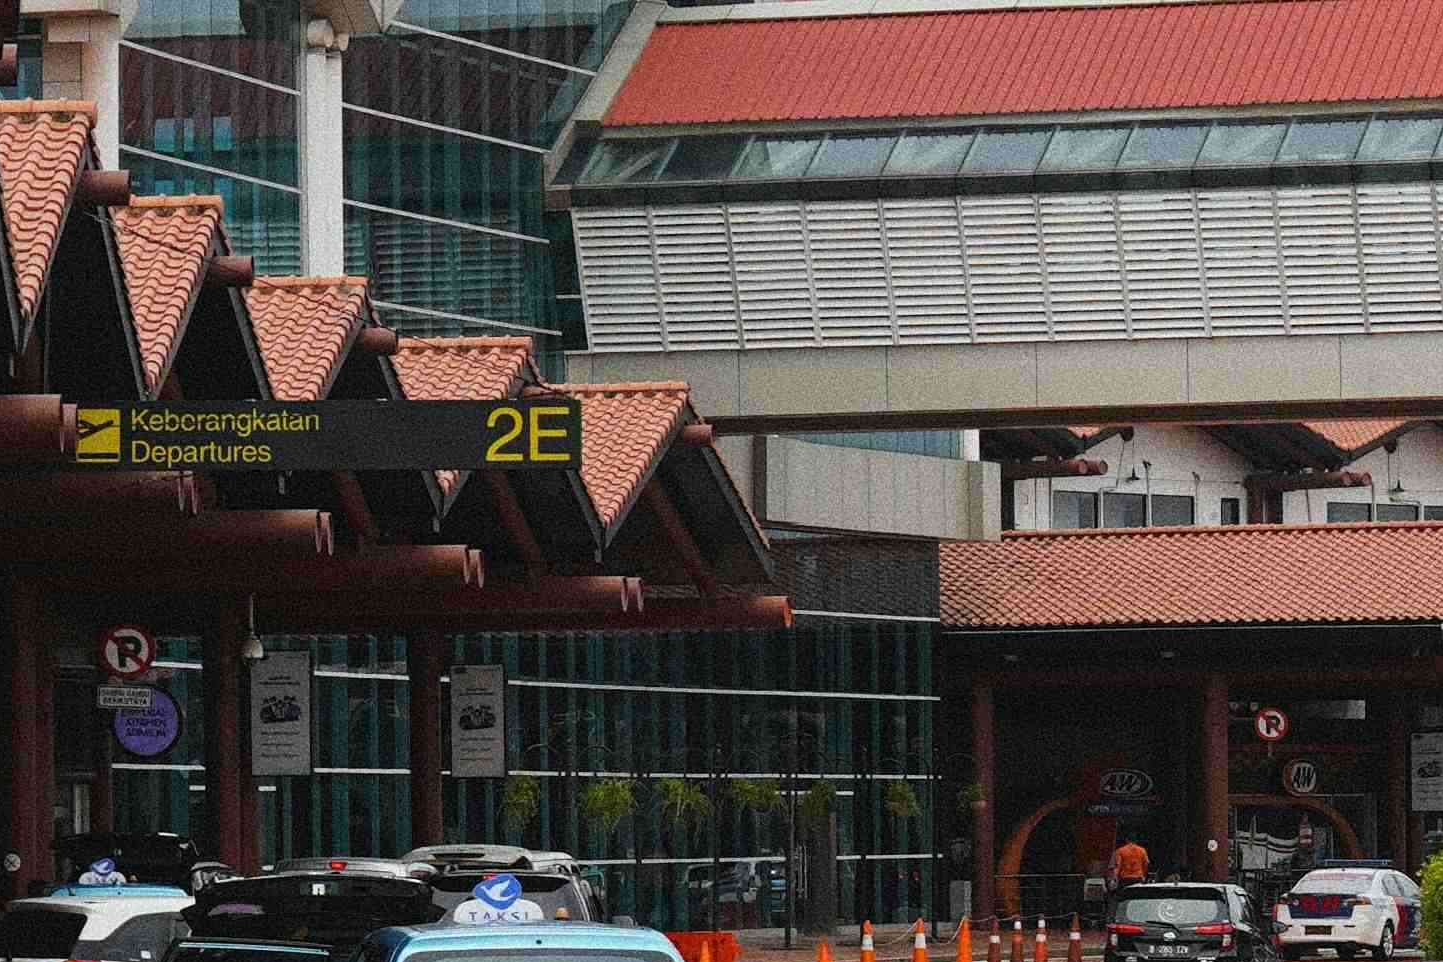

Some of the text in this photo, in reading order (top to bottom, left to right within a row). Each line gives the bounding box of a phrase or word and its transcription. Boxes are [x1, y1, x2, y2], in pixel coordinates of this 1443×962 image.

[131, 407, 571, 463] Keberangkatan 2E
[131, 440, 273, 467] Departures
[468, 911, 529, 923] TAKSI
